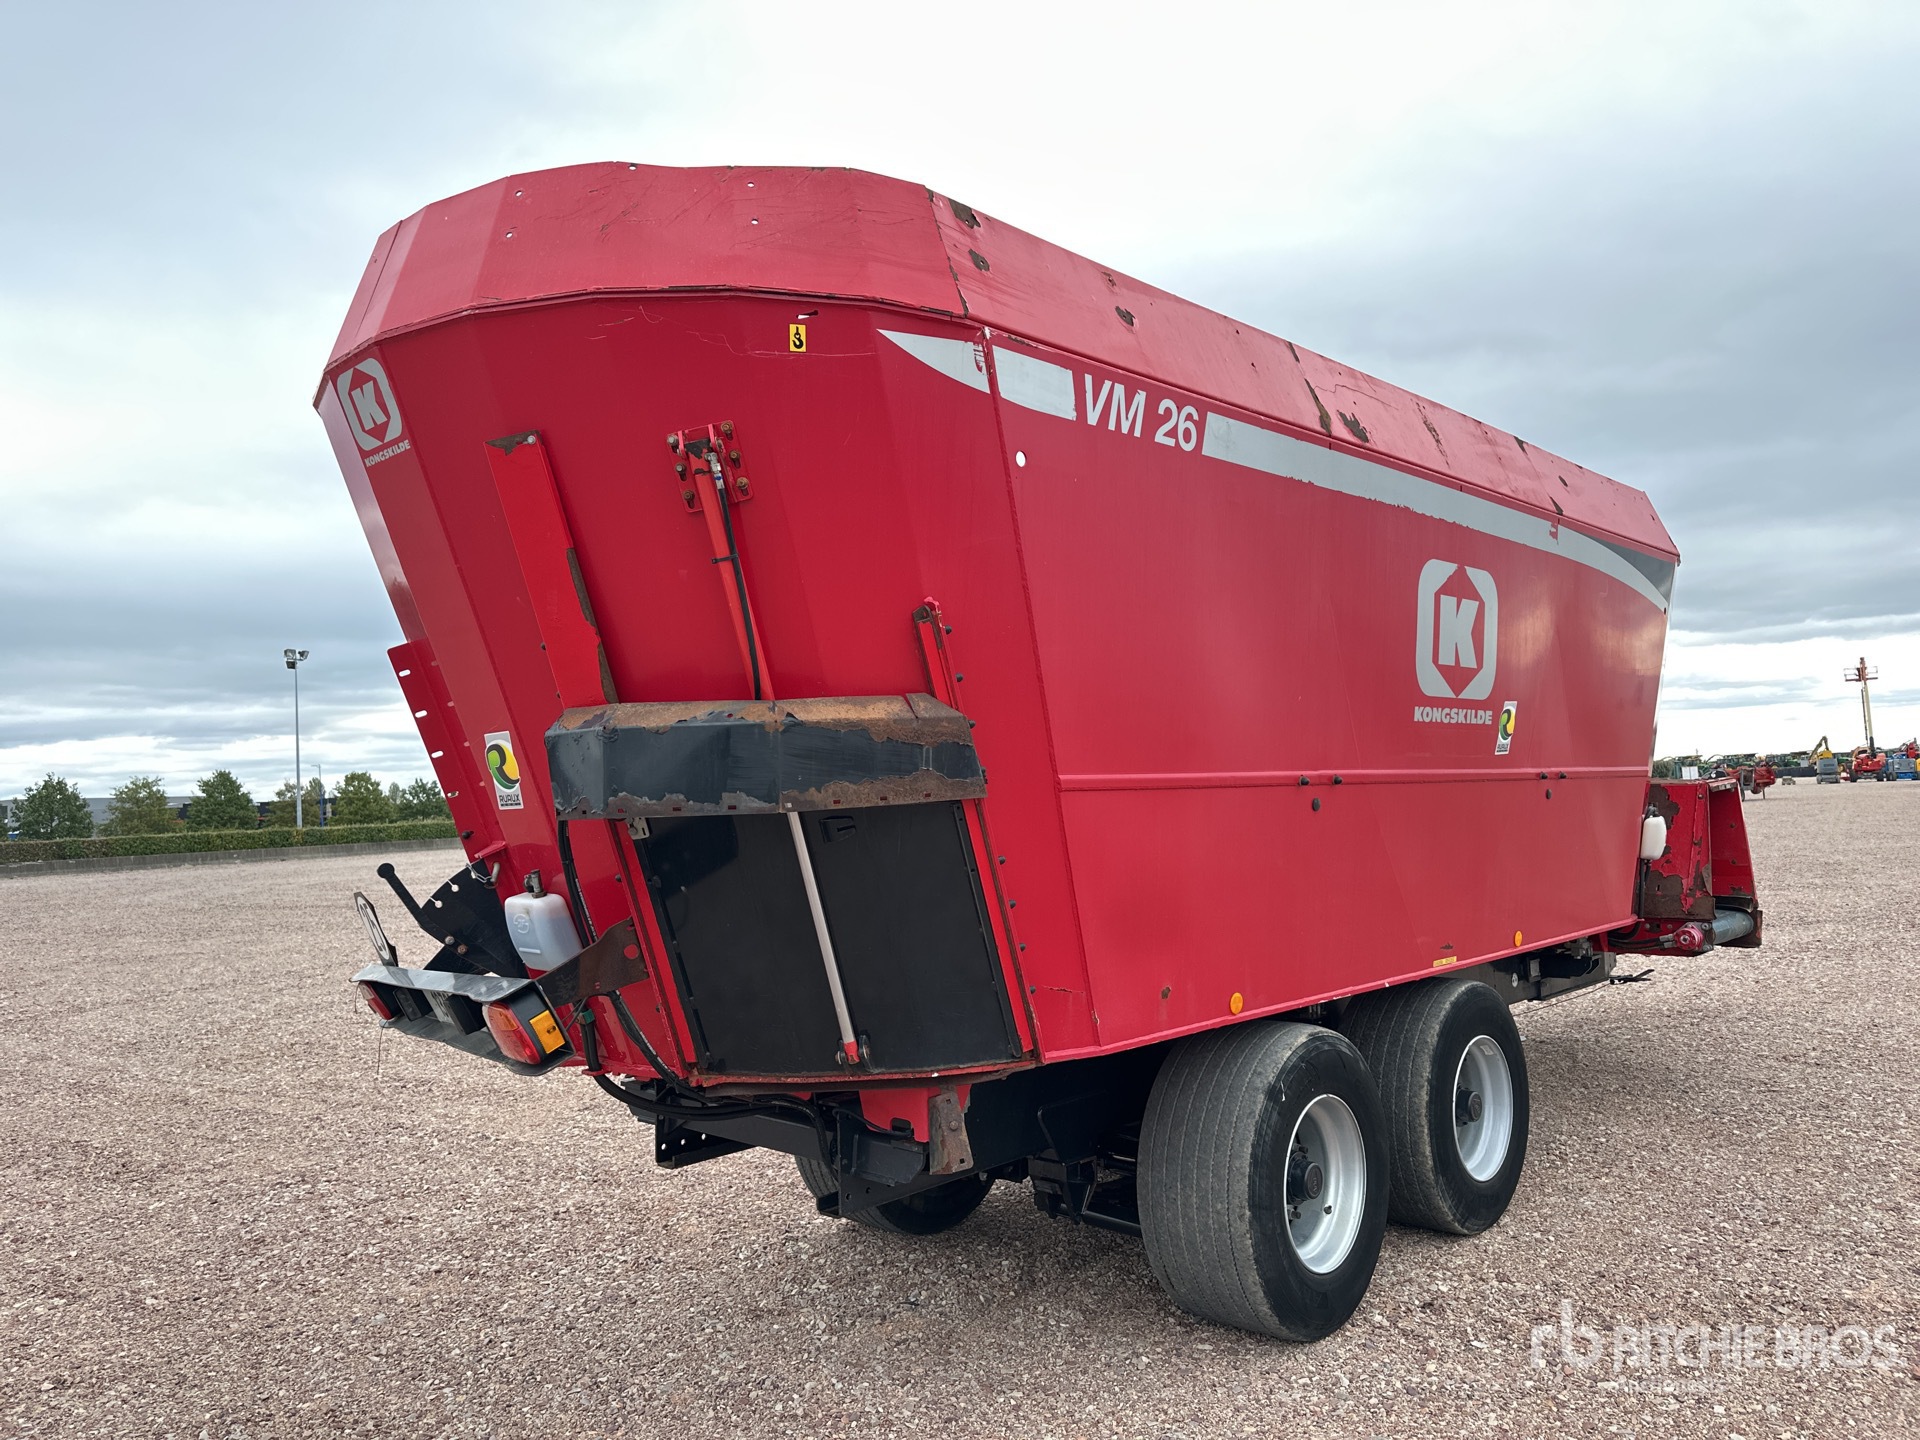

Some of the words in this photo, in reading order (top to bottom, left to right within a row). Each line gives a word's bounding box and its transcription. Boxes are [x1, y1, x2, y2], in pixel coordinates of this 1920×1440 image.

[351, 380, 388, 431] K
[1084, 373, 1147, 438] VM
[1154, 398, 1199, 452] 26
[364, 439, 411, 468] KONGSKILDE
[1438, 594, 1480, 669] K
[1413, 706, 1493, 725] KONGSKILDE
